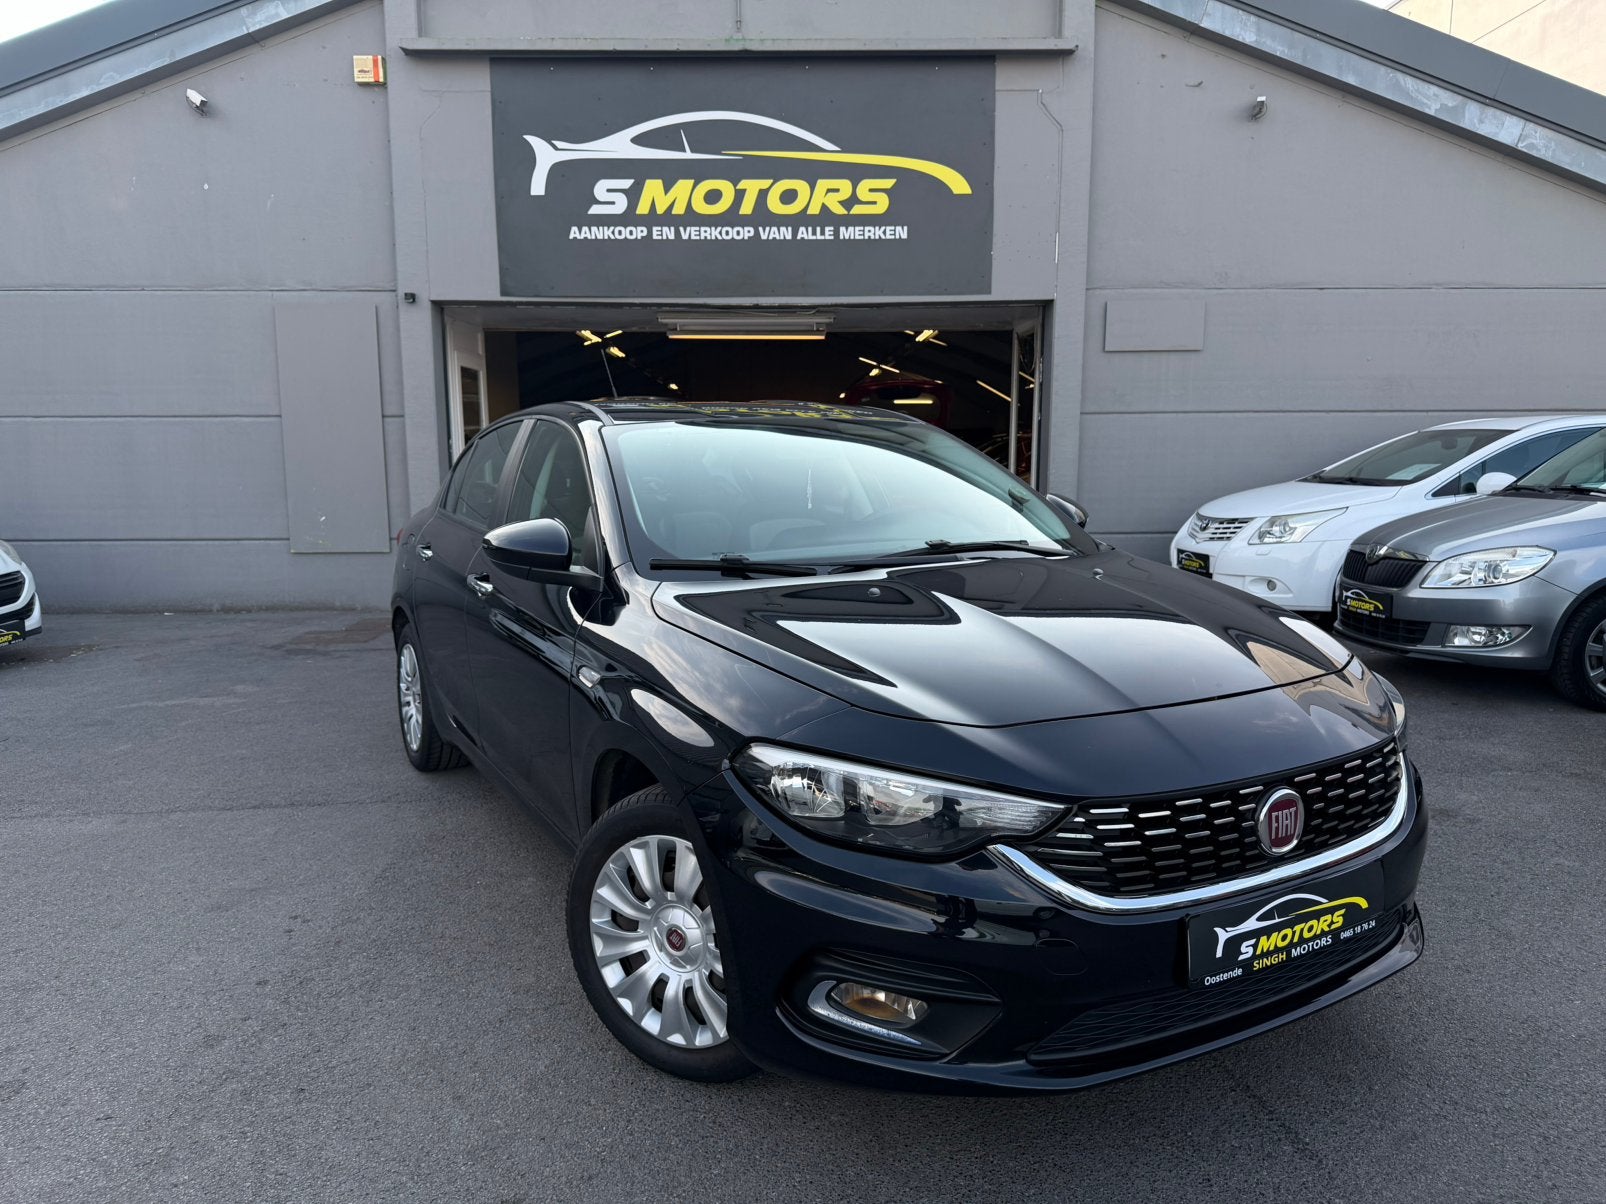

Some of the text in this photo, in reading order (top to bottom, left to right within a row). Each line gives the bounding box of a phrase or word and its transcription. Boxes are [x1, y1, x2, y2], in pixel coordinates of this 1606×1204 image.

[587, 179, 897, 215] S MOTORS
[569, 225, 908, 241] AANKOOP EN VERKOOP VAN ALLE MERKEN
[1271, 806, 1297, 840] FIAT
[1204, 919, 1376, 986] Oostende SINGH MOTORS 0465 18 76 24
[1237, 908, 1346, 961] S MOTORS
